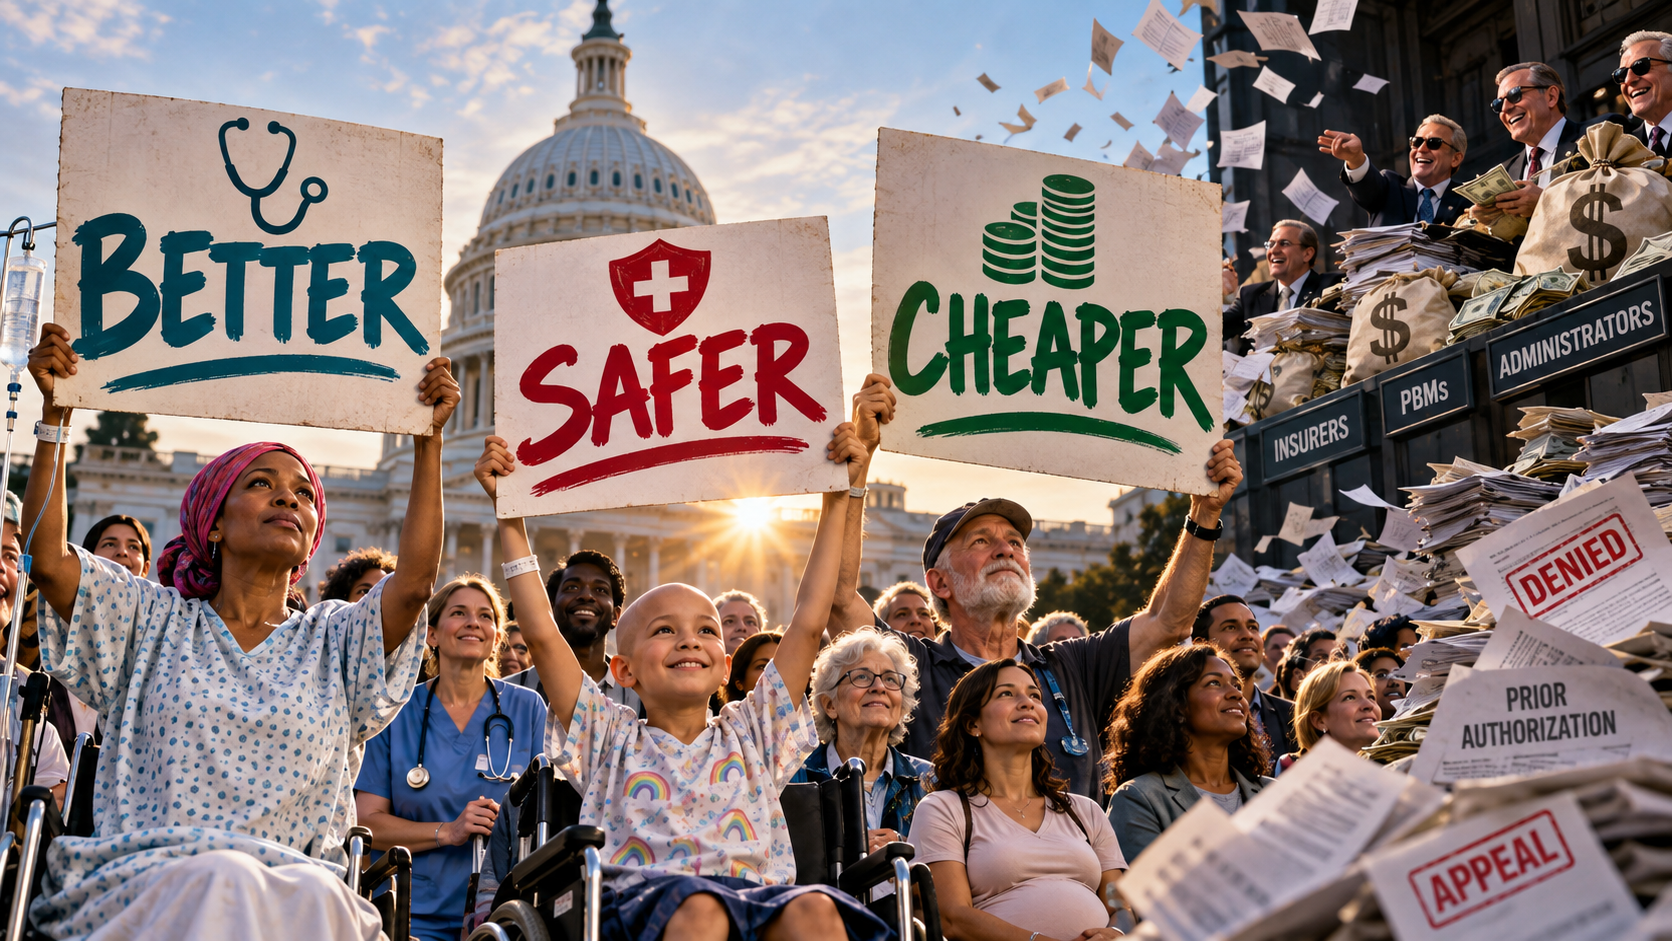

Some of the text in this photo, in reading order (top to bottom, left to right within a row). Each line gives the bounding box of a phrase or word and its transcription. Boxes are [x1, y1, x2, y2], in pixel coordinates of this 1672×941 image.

[71, 213, 430, 361] BETTER
[888, 279, 1212, 432] CHEAPER
[1499, 300, 1655, 379] ADMINISTRATORS
[515, 321, 829, 466] SAFER
[1400, 378, 1450, 415] PBMs
[1274, 414, 1350, 463] INSURERS
[1518, 528, 1627, 607] DENIED
[1461, 710, 1617, 750] AUTHORIZATION
[1506, 681, 1568, 712] PRIOR
[1429, 829, 1560, 915] APPEAL
